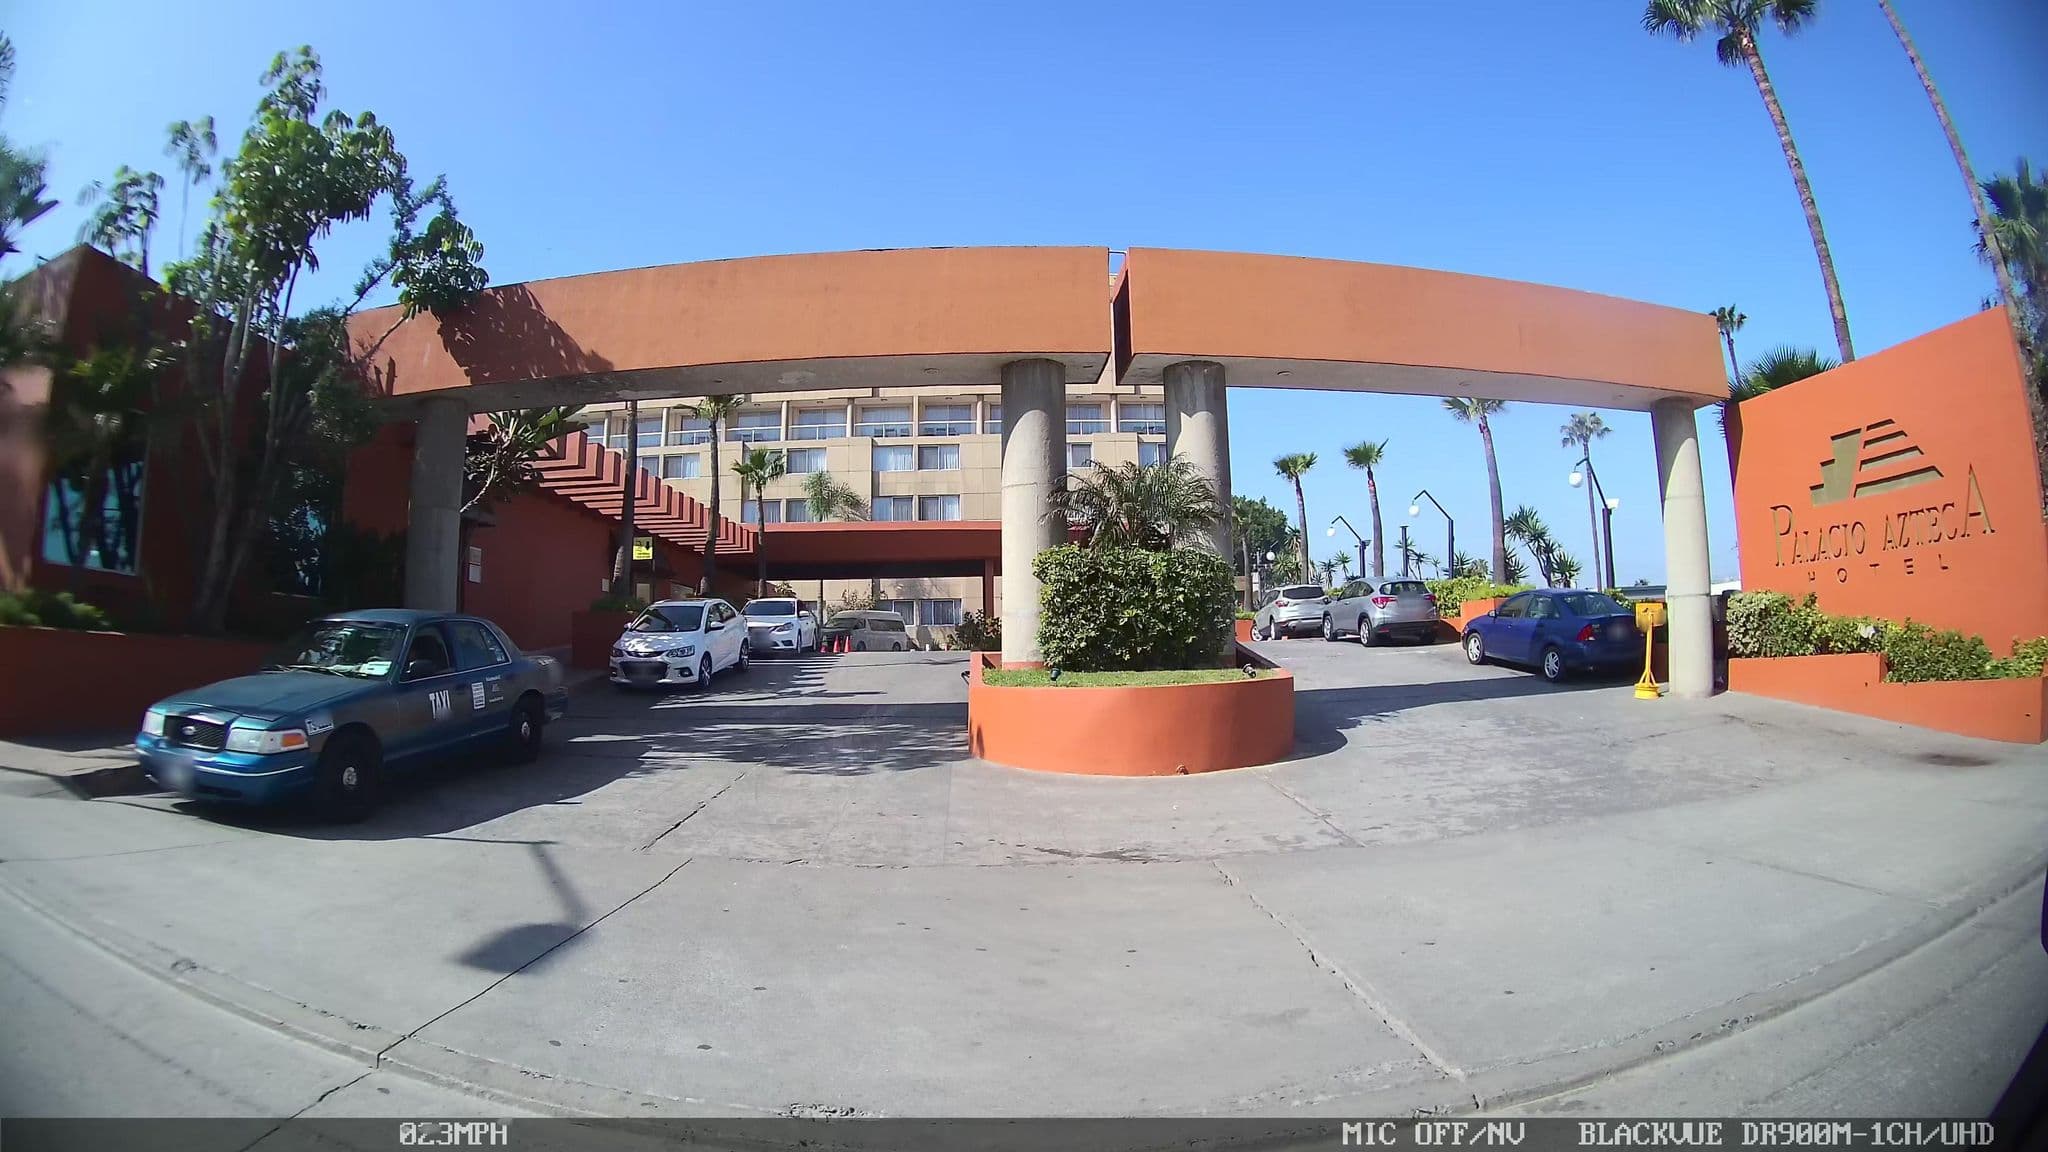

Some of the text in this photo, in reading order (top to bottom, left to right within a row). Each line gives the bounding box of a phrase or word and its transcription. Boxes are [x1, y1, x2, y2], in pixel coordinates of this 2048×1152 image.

[1770, 463, 1996, 566] PALACIO AZTECA
[1808, 553, 1949, 583] HOTEL
[428, 689, 451, 720] TAXI
